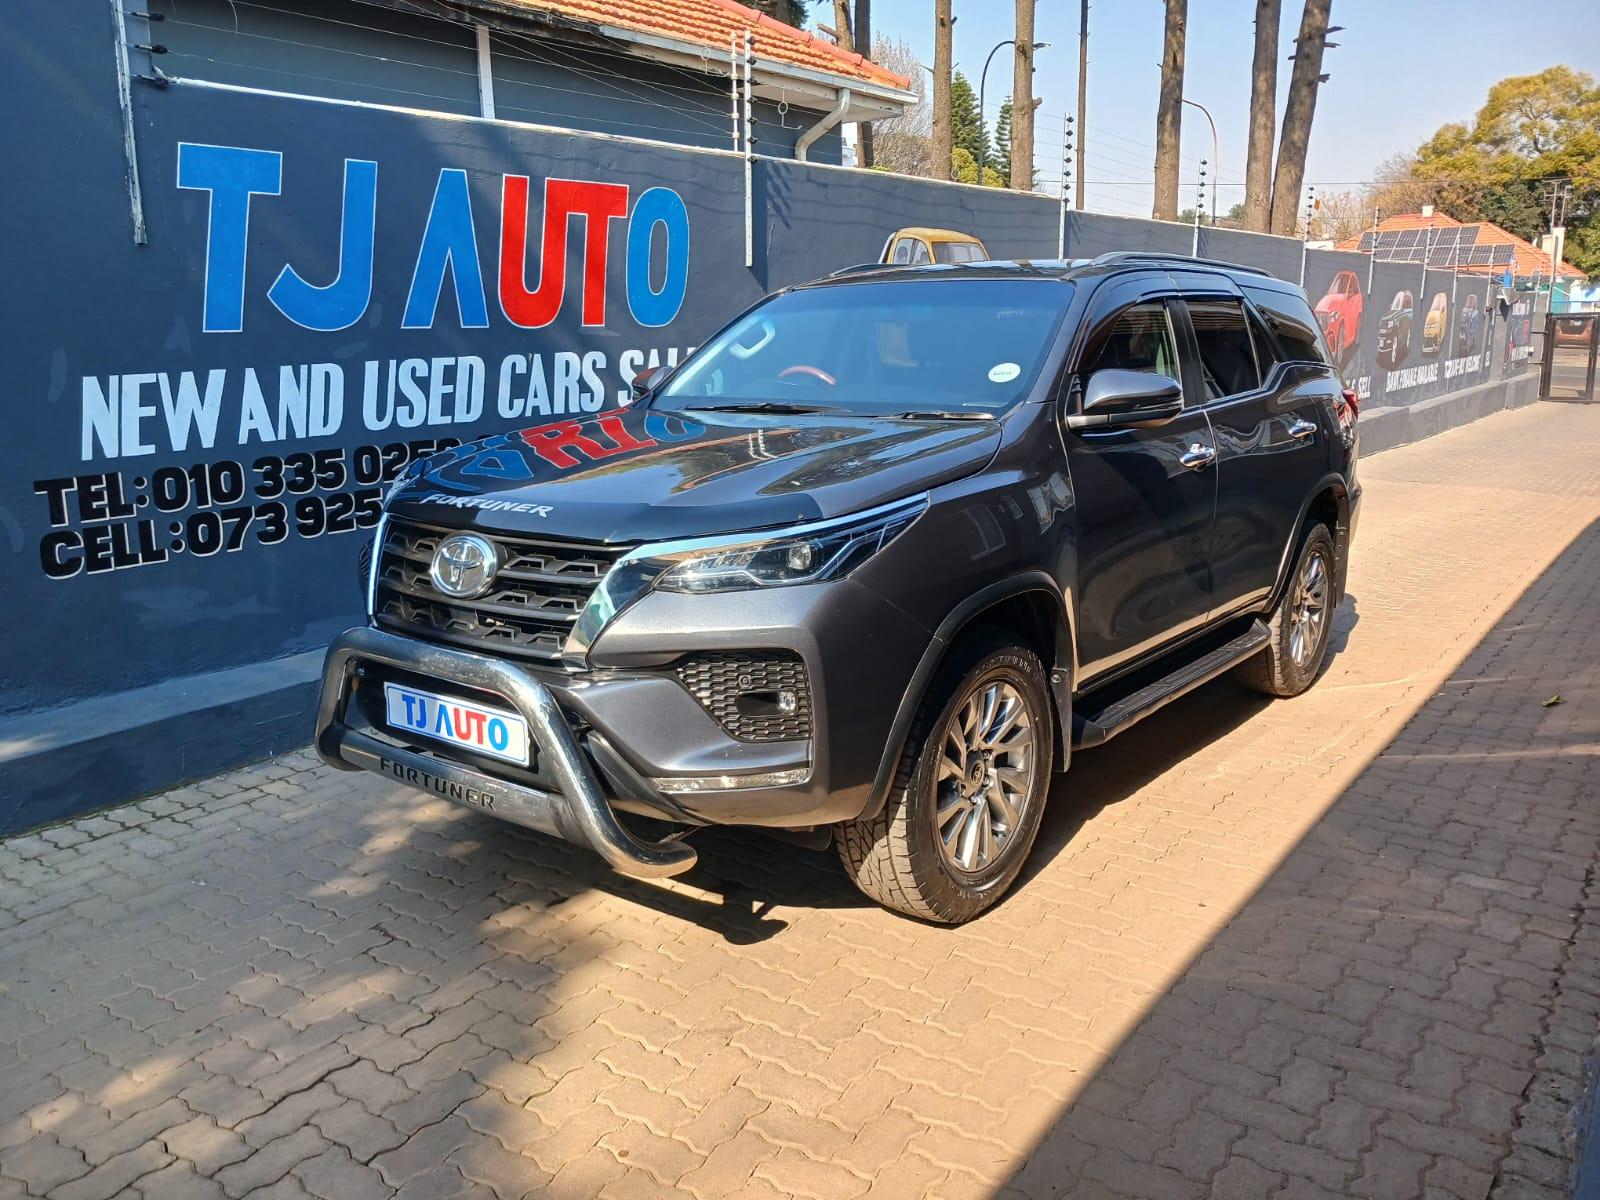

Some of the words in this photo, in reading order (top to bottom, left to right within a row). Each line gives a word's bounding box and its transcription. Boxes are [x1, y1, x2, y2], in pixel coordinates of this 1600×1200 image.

[177, 142, 378, 333] TJ
[401, 168, 690, 329] AUTO
[81, 368, 226, 460] NEW
[238, 362, 345, 445] AND
[364, 355, 486, 431] USED
[498, 350, 607, 419] CARS
[252, 448, 348, 500] 335
[295, 488, 385, 538] 925
[419, 493, 554, 518] FORTUNER
[401, 693, 427, 729] TJ
[435, 703, 509, 751] AUTO
[379, 757, 497, 811] FORTUNER
